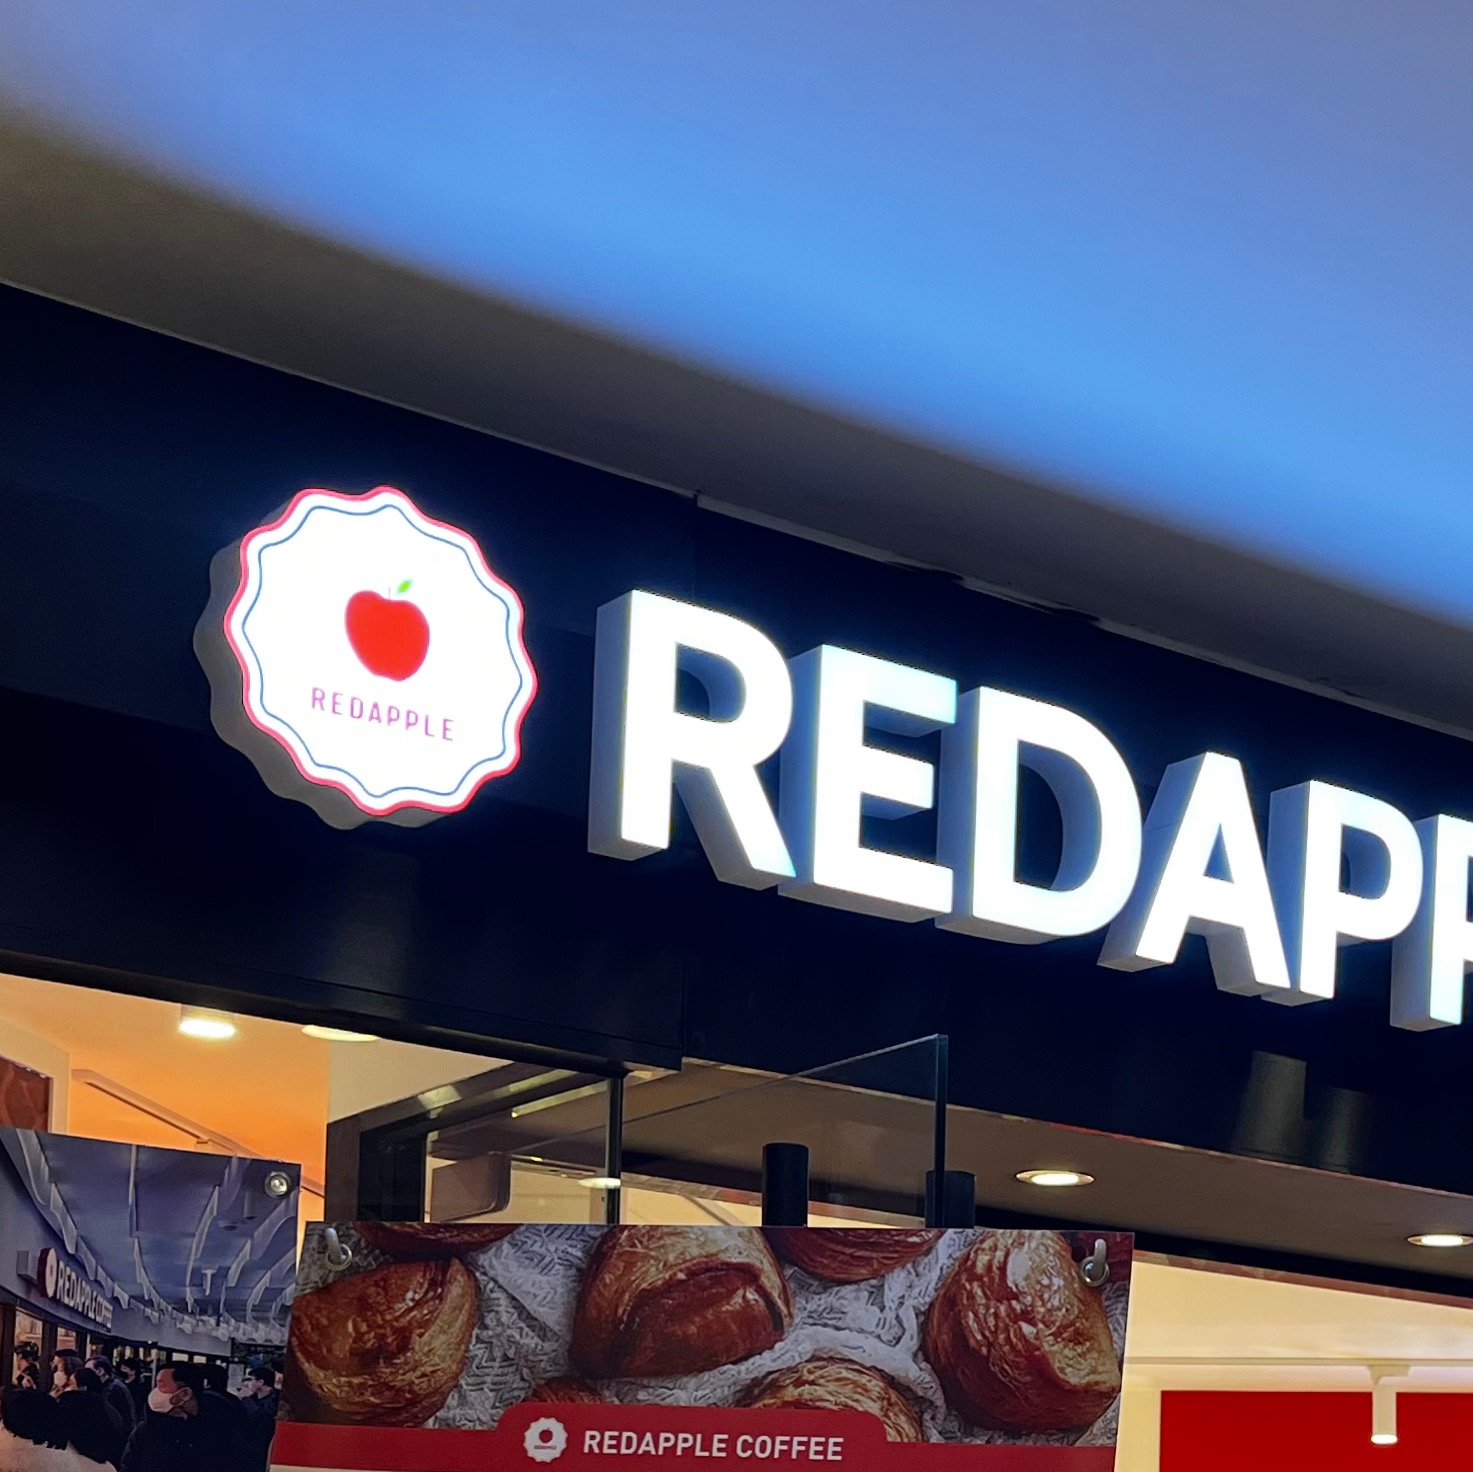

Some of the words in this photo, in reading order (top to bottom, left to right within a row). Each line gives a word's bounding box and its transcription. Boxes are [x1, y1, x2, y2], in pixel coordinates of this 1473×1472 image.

[311, 687, 455, 742] REDAPPLE
[582, 1431, 728, 1458] REDAPPLE
[736, 1433, 844, 1461] COFFEE
